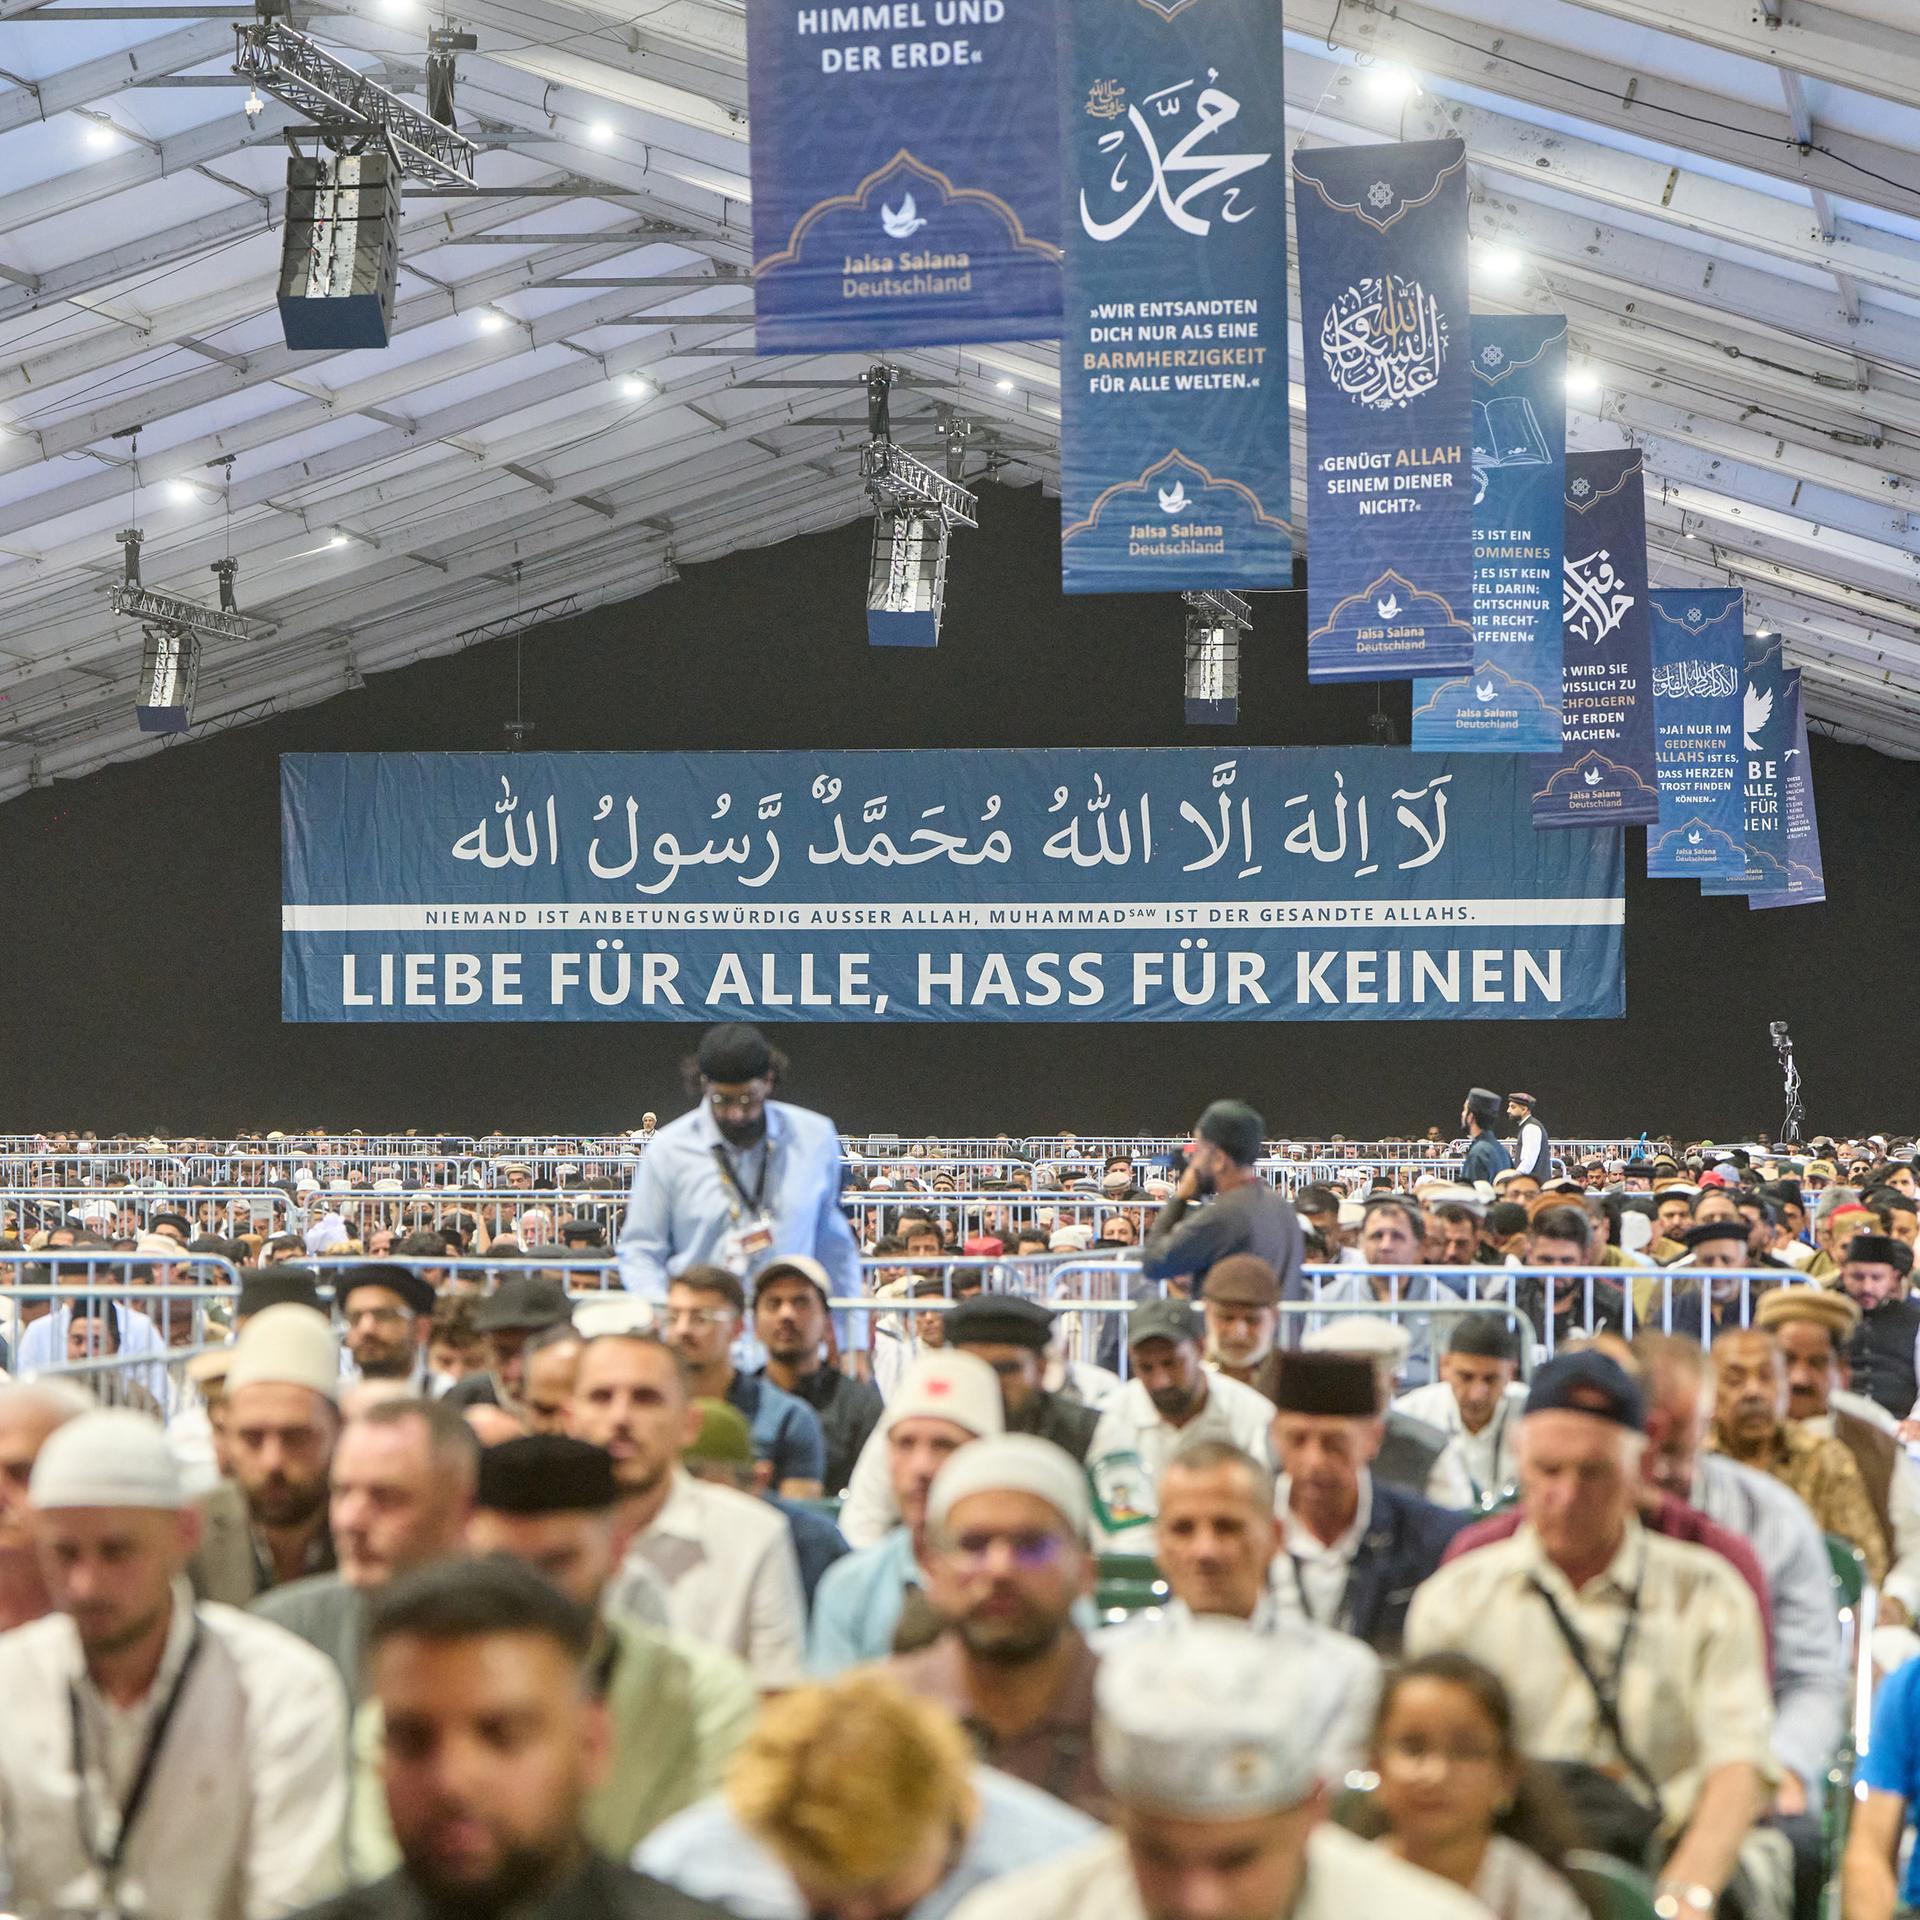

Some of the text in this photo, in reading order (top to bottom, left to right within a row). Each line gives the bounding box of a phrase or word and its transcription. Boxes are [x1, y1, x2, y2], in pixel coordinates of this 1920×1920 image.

[797, 0, 1005, 35] HIMMEL UND
[821, 41, 982, 73] DER ERDE«
[842, 250, 971, 274] Jalsa Salana
[842, 273, 972, 298] Deutschland
[1090, 299, 1258, 319] »WIR ENTSANDTEN
[1090, 322, 1258, 343] DICH NUR ALS EINE
[1083, 347, 1266, 370] BARMHERZIGKEIT
[1090, 373, 1260, 393] FÜR ALLE WELTEN.«
[1318, 446, 1461, 472] »GENÜGT ALLAH
[1328, 473, 1453, 494] SEINEM DIENER
[1359, 498, 1421, 515] NICHT?«
[1129, 523, 1223, 540] Jalsa Salana
[1488, 530, 1507, 540] IST
[1510, 530, 1531, 540] EIN
[1129, 540, 1224, 556] Deutschland
[1474, 547, 1551, 559] OMMENES
[1481, 568, 1495, 578] ES
[1499, 568, 1518, 578] IST
[1521, 568, 1550, 579] KEIN
[1496, 584, 1540, 594] DARIN:
[1473, 600, 1550, 610] CHTSCHNUR
[1492, 615, 1539, 626] RECHT-
[1356, 627, 1425, 640] Jalsa Salana
[1356, 639, 1425, 653] Deutschland
[1570, 665, 1605, 676] WIRD
[1609, 664, 1628, 674] SIE
[1619, 679, 1636, 690] ZU
[1456, 708, 1518, 718] Jalsa Salana
[1583, 712, 1625, 724] ERDEN
[1456, 719, 1519, 729] Deutschland
[1660, 725, 1731, 734] »JA! NUR IM
[1664, 739, 1726, 749] GEDENKEN
[1707, 754, 1722, 763] IST
[1725, 754, 1739, 764] ES,
[1657, 768, 1733, 778] DASS HERZEN
[1748, 761, 1777, 779] BE
[1660, 782, 1731, 791] TROST FINDEN
[1569, 789, 1621, 800] Jalsa Salana
[1569, 799, 1622, 809] Deutschland
[1750, 799, 1778, 814] FÜR
[425, 910, 528, 925] NIEMAND
[538, 910, 569, 924] IST
[579, 907, 801, 924] ANBETUNGSWÜRDIG
[811, 909, 892, 924] AUSSER
[902, 909, 978, 926] ALLAH,
[1165, 909, 1199, 923] IST
[1209, 908, 1250, 923] DER
[1260, 907, 1374, 922] GESANDTE
[1384, 906, 1476, 921] ALLAHS.
[342, 938, 1563, 1015] LIEBE FÜR ALLE, HASS FÜR KEINEN
